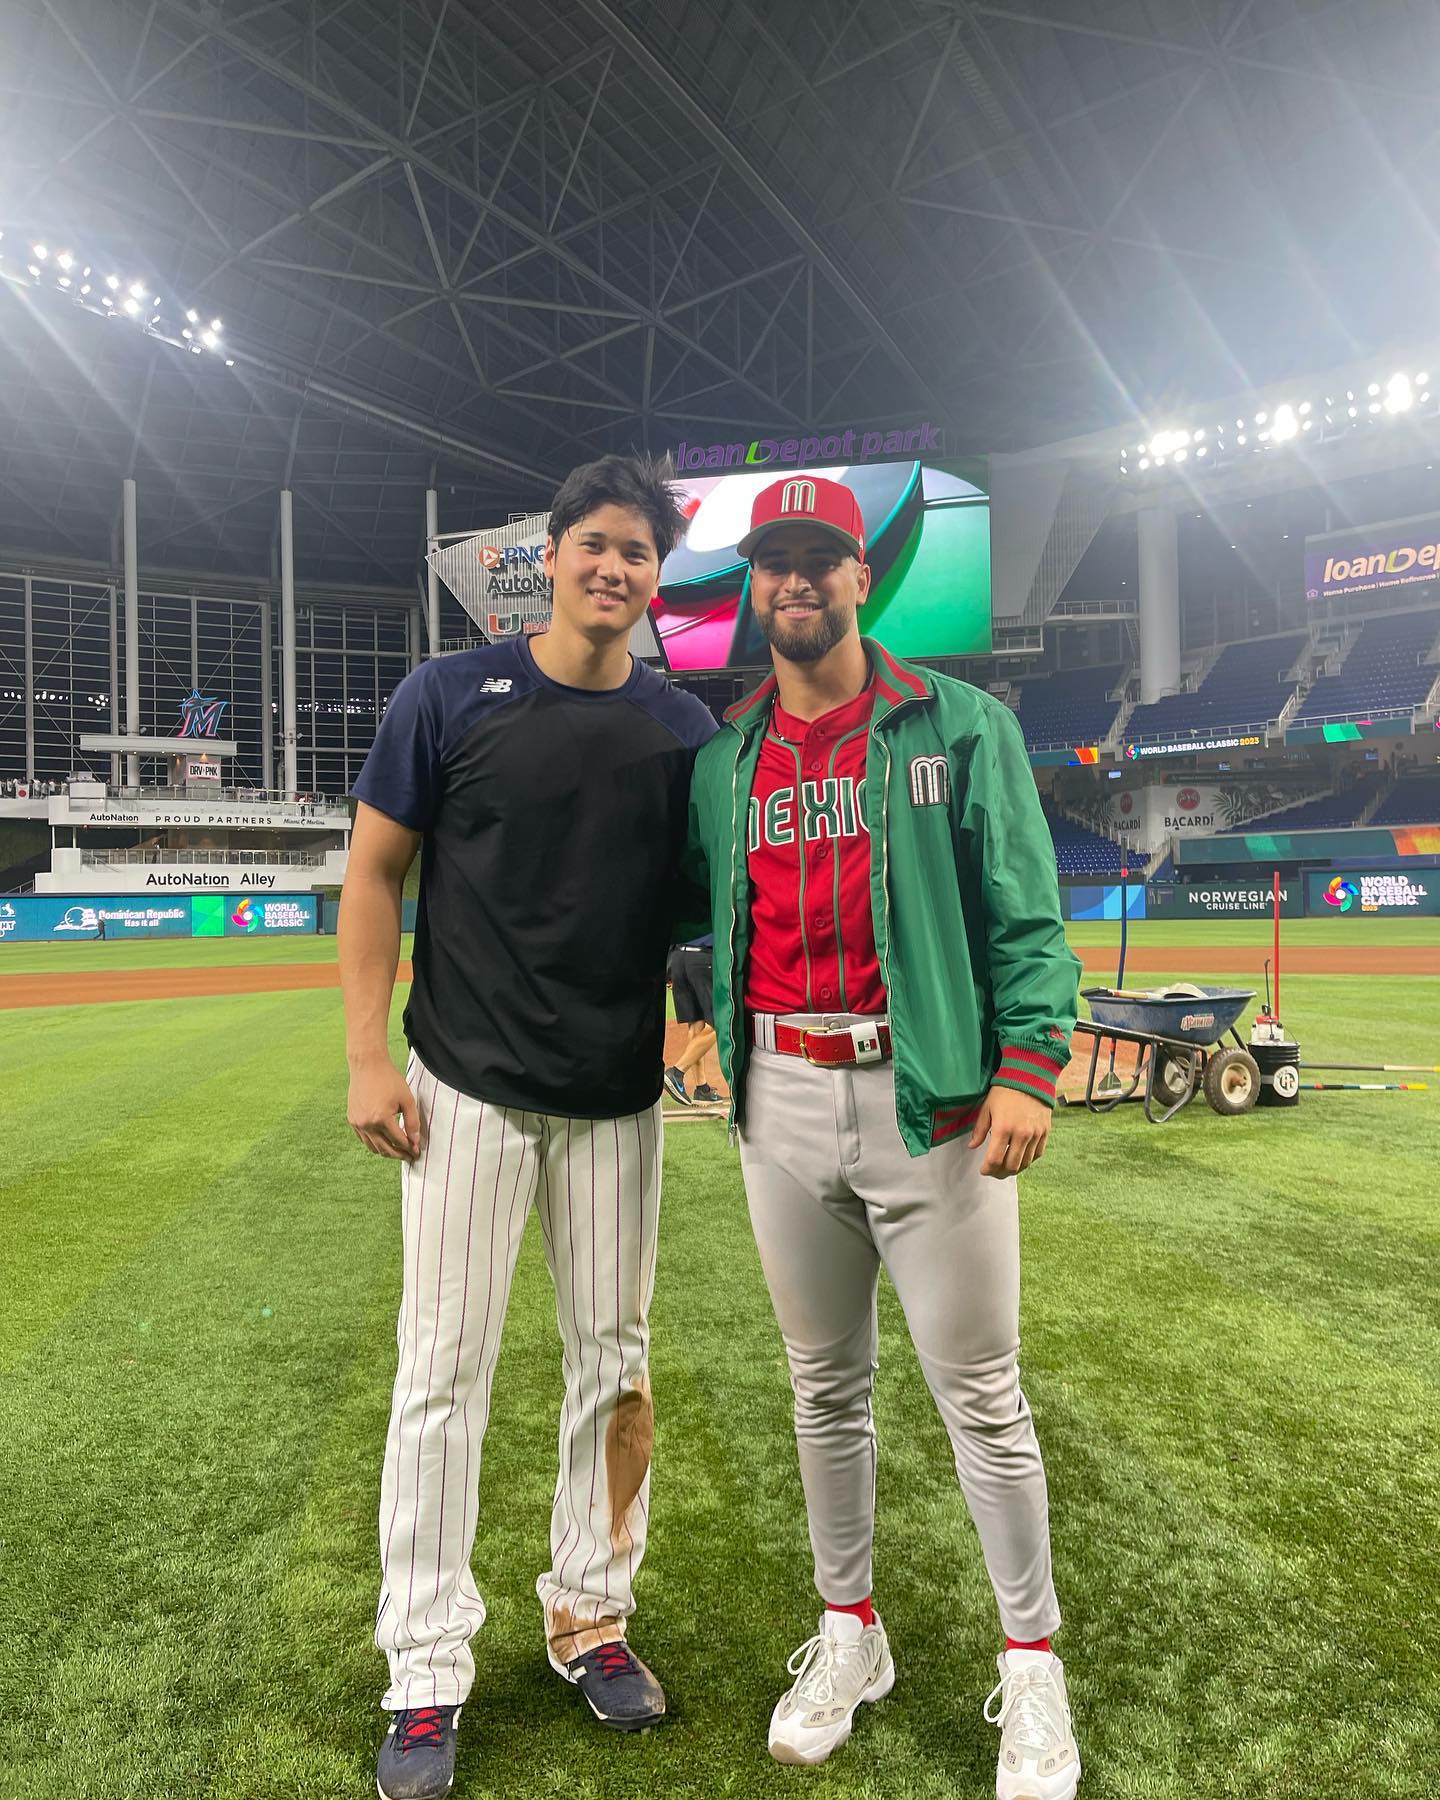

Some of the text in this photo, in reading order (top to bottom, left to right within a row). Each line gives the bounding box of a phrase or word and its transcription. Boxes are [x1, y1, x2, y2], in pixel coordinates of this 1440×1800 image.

[677, 422, 941, 471] loanDepot park
[1140, 736, 1260, 755] WORLD BASEBALL CLASSIC 2023
[90, 813, 139, 822] AutoNation
[155, 815, 201, 823] PROUD
[208, 816, 272, 825] PARTNERS
[146, 873, 275, 888] AutoNation Alley
[1360, 875, 1409, 887] WORLD
[1188, 890, 1288, 903] NORWEGIAN
[1360, 885, 1428, 896] BASEBALL
[264, 903, 298, 912] WORLD
[1206, 902, 1240, 910] CRUISE
[98, 908, 185, 920] Dominican Republic
[264, 911, 310, 920] BASEBALL
[124, 919, 140, 927] Has
